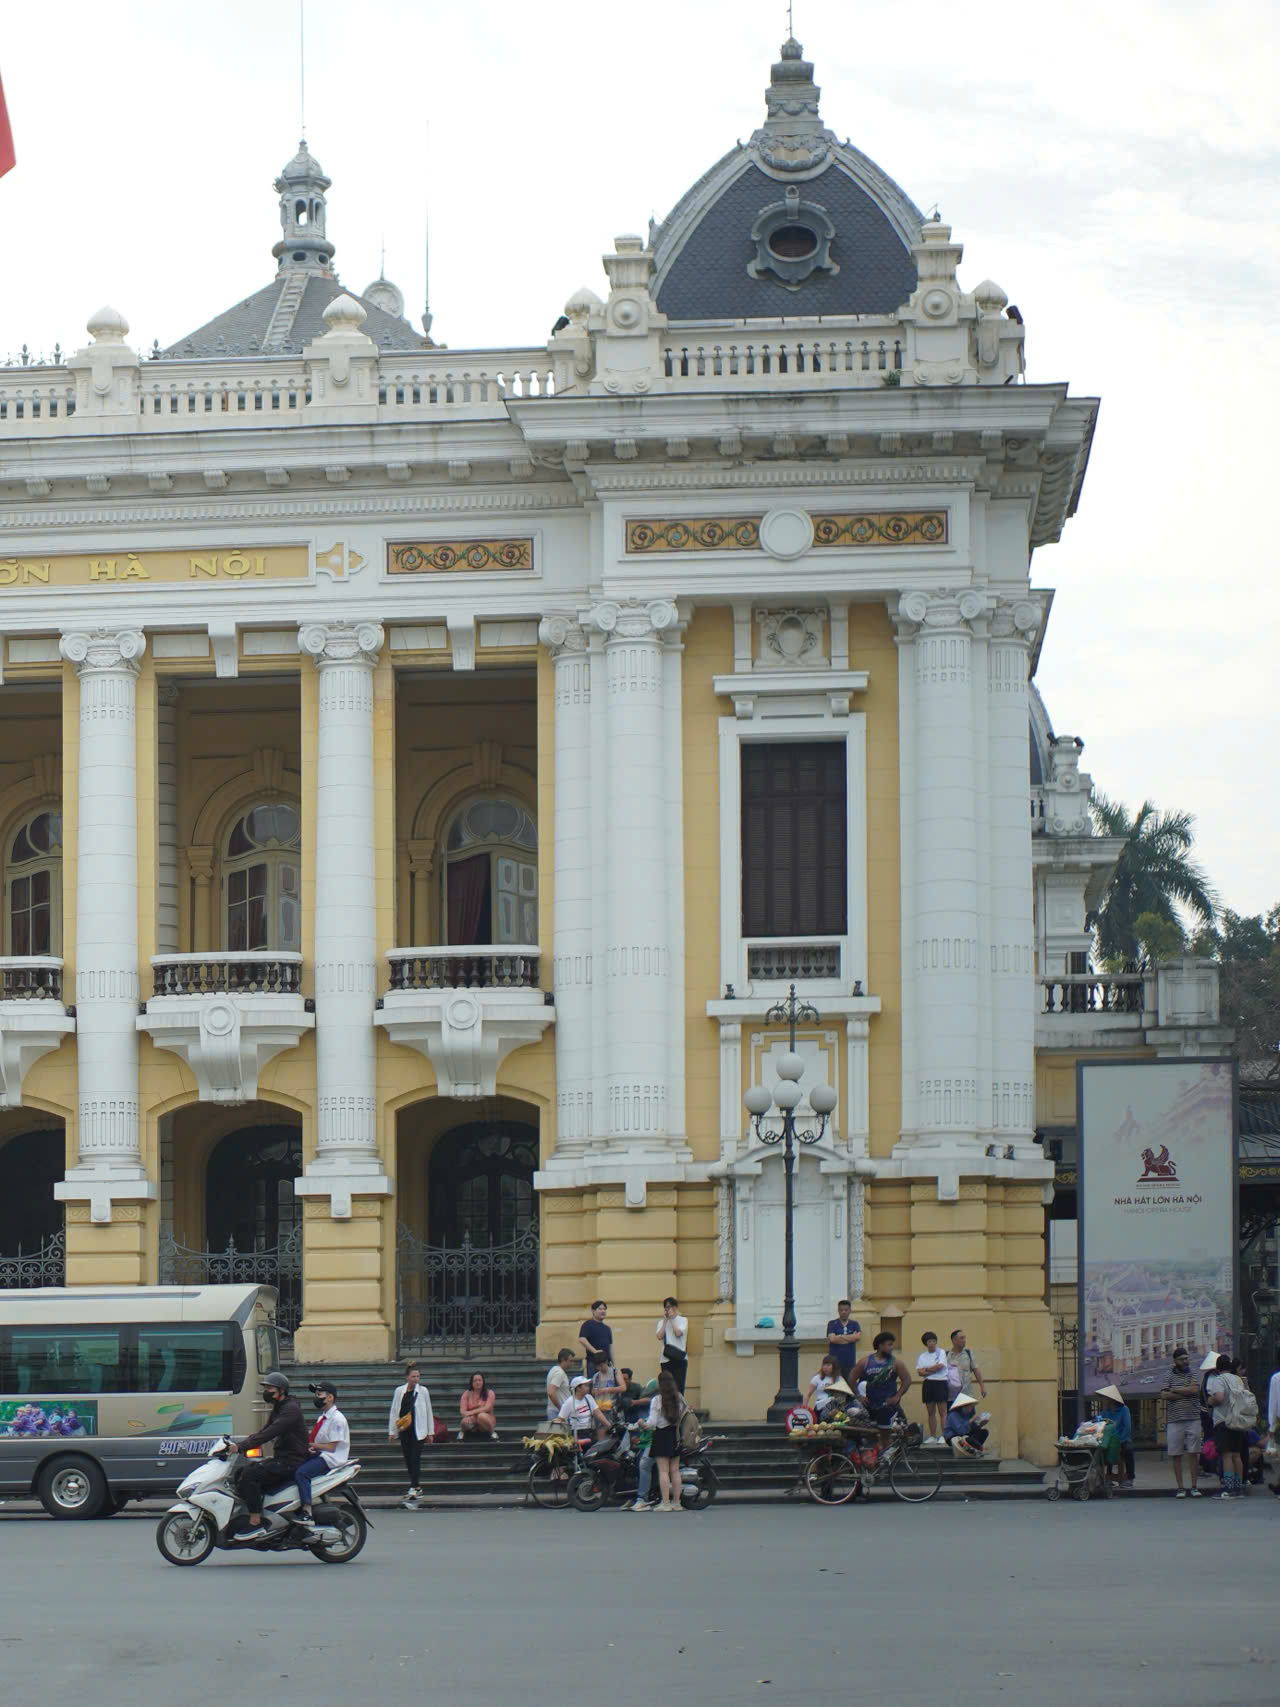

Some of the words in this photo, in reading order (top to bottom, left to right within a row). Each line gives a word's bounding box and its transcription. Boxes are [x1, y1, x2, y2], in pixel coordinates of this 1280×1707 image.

[88, 553, 151, 580] HÀ
[188, 549, 266, 579] NỘI
[1114, 1196, 1132, 1205] NHÀ
[1134, 1195, 1150, 1204] HÁT
[1172, 1194, 1184, 1203] HÀ
[1186, 1194, 1202, 1205] NỘI
